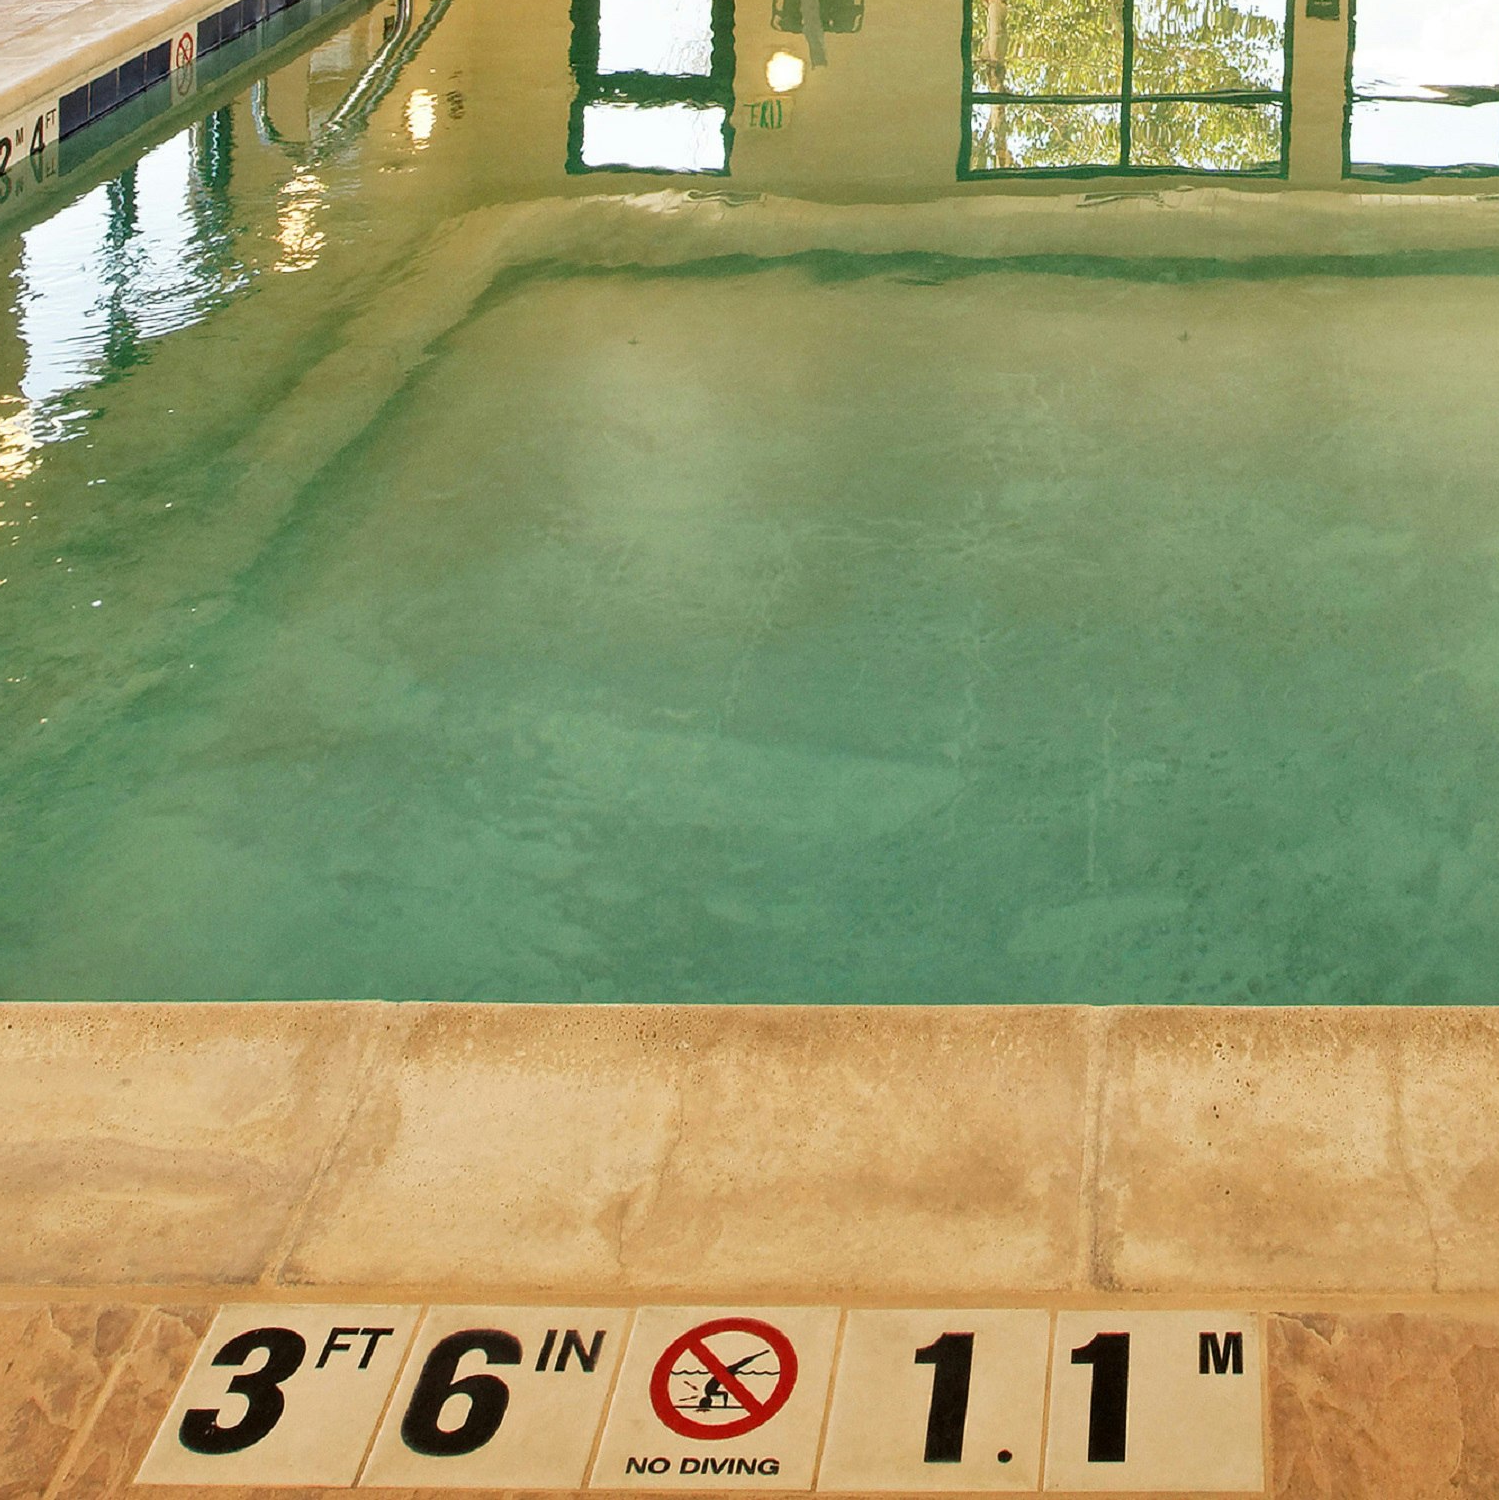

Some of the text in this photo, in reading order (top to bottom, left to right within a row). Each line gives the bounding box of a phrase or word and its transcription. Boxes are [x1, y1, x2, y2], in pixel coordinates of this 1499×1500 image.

[15, 126, 24, 146] M
[29, 114, 46, 156] 4
[46, 108, 57, 129] FT
[1196, 1331, 1244, 1376] M
[178, 1326, 607, 1458] 3 FT 6 IN
[624, 1456, 781, 1478] NO DIVING
